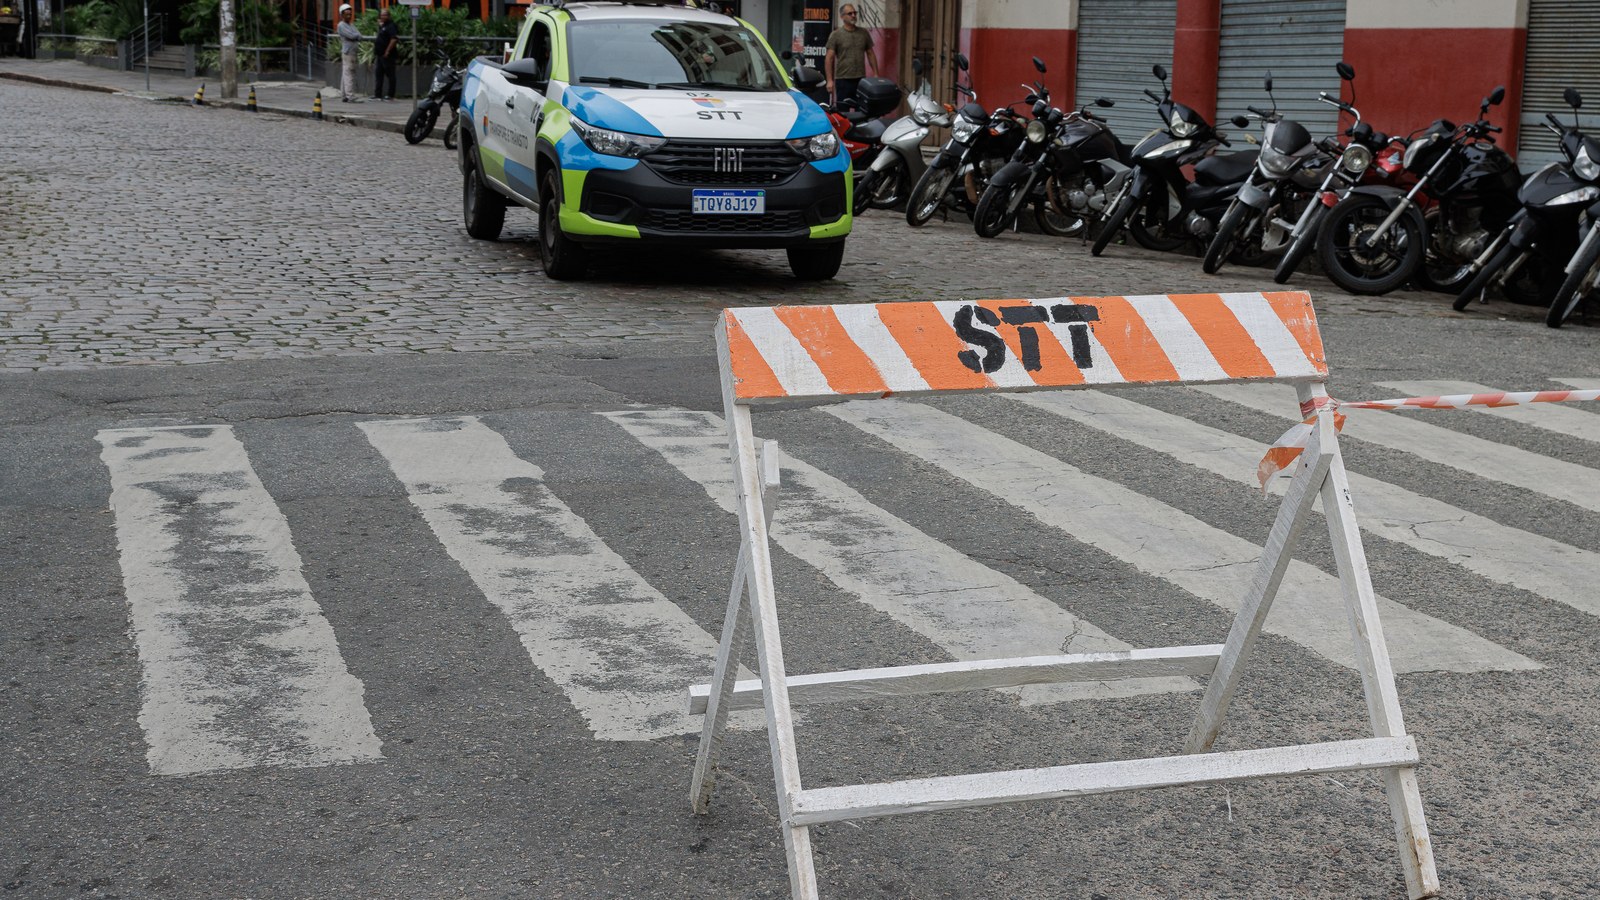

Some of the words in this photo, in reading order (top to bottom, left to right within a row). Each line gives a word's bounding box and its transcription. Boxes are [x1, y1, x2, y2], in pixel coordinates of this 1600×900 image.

[696, 110, 743, 121] STT
[714, 147, 745, 173] FIAT
[699, 198, 757, 212] TQY8J19
[952, 303, 1100, 374] STT
